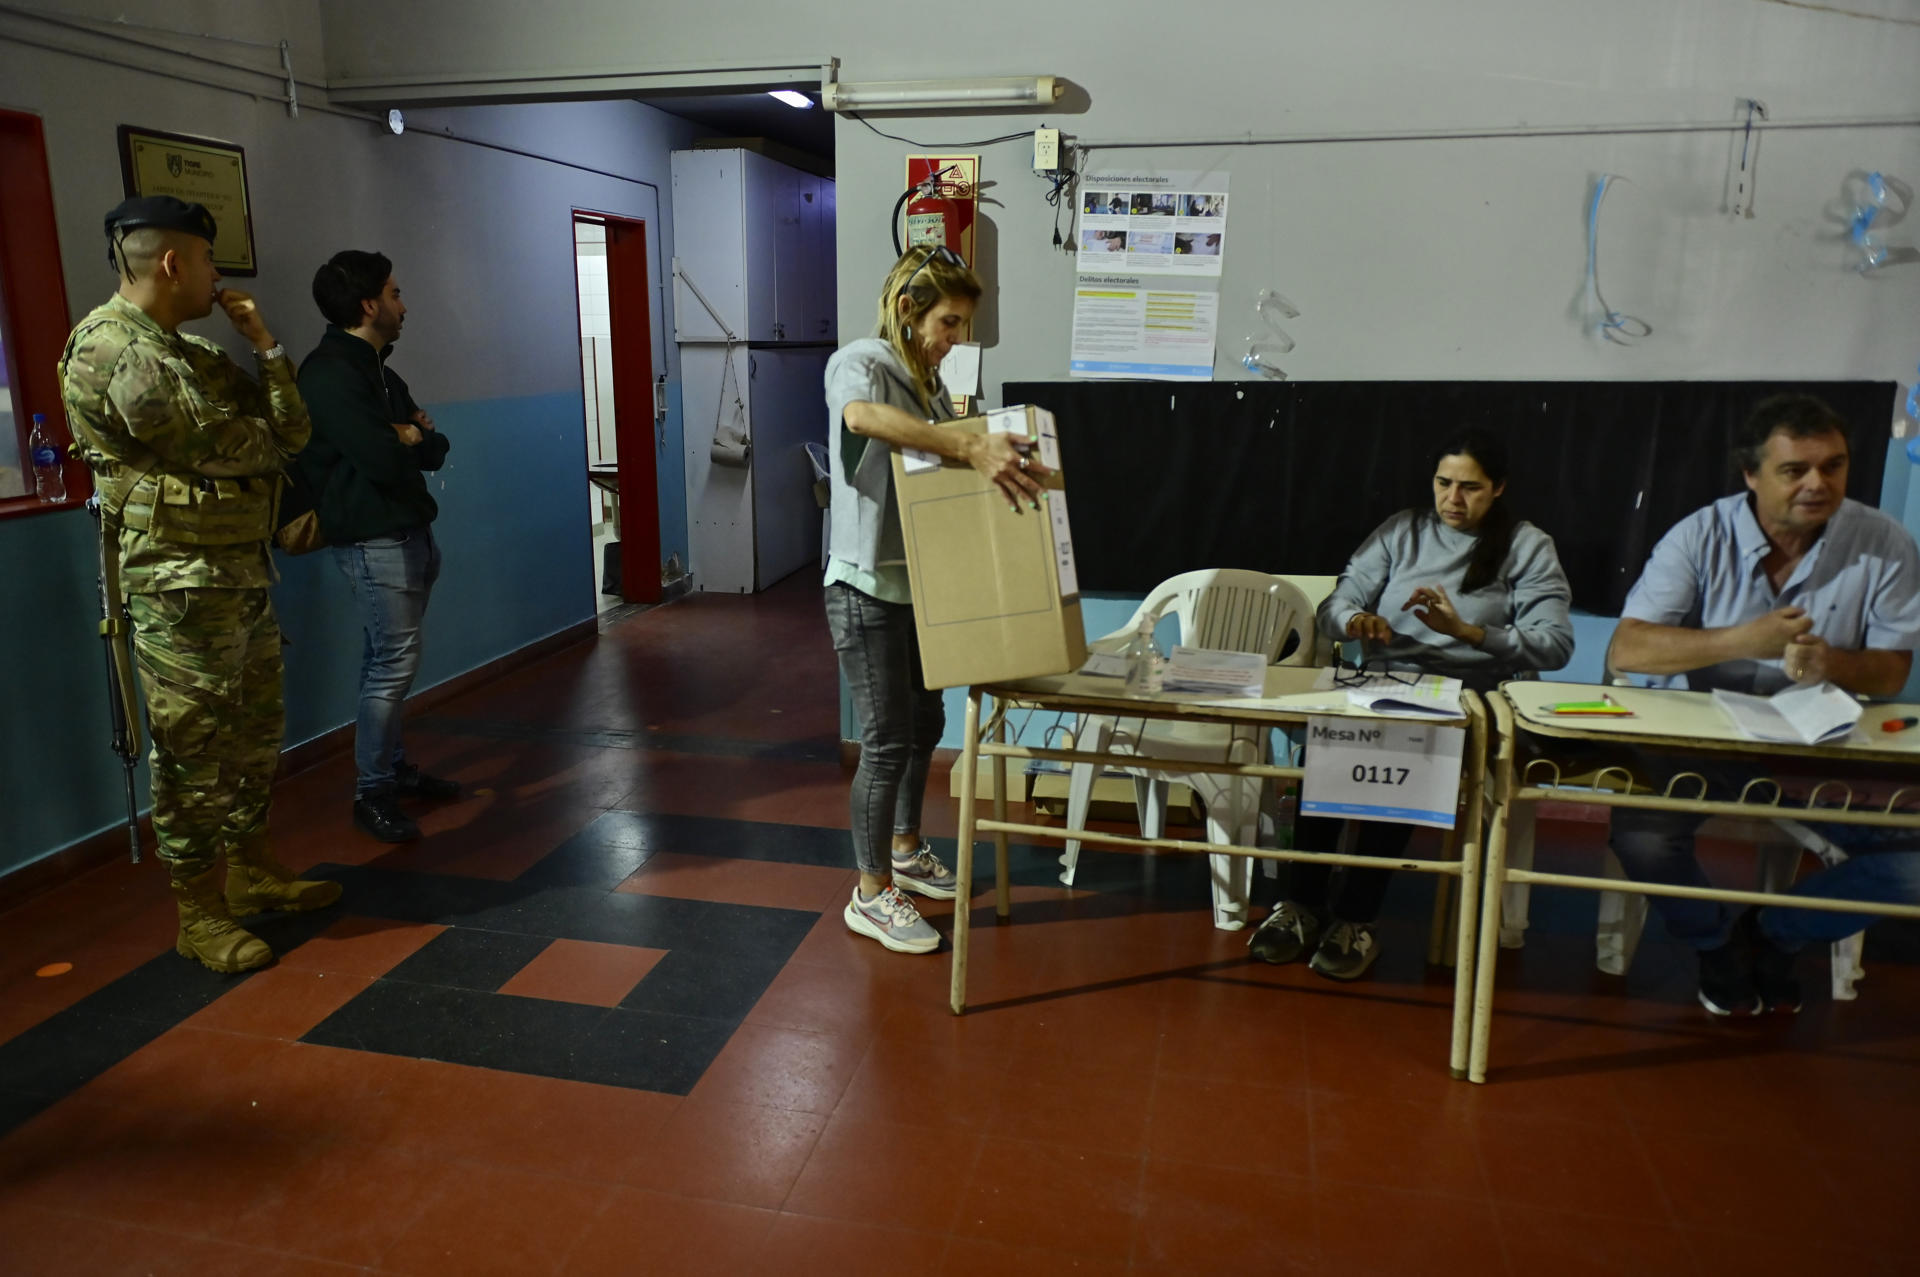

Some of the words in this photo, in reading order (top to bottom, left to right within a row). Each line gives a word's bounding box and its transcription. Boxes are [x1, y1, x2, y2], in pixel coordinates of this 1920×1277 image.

[1085, 175, 1131, 183] Disposiciones
[1079, 275, 1102, 283] Delitos
[1103, 276, 1139, 284] electorales
[1312, 726, 1355, 742] Mesa
[1352, 764, 1410, 786] 0117
